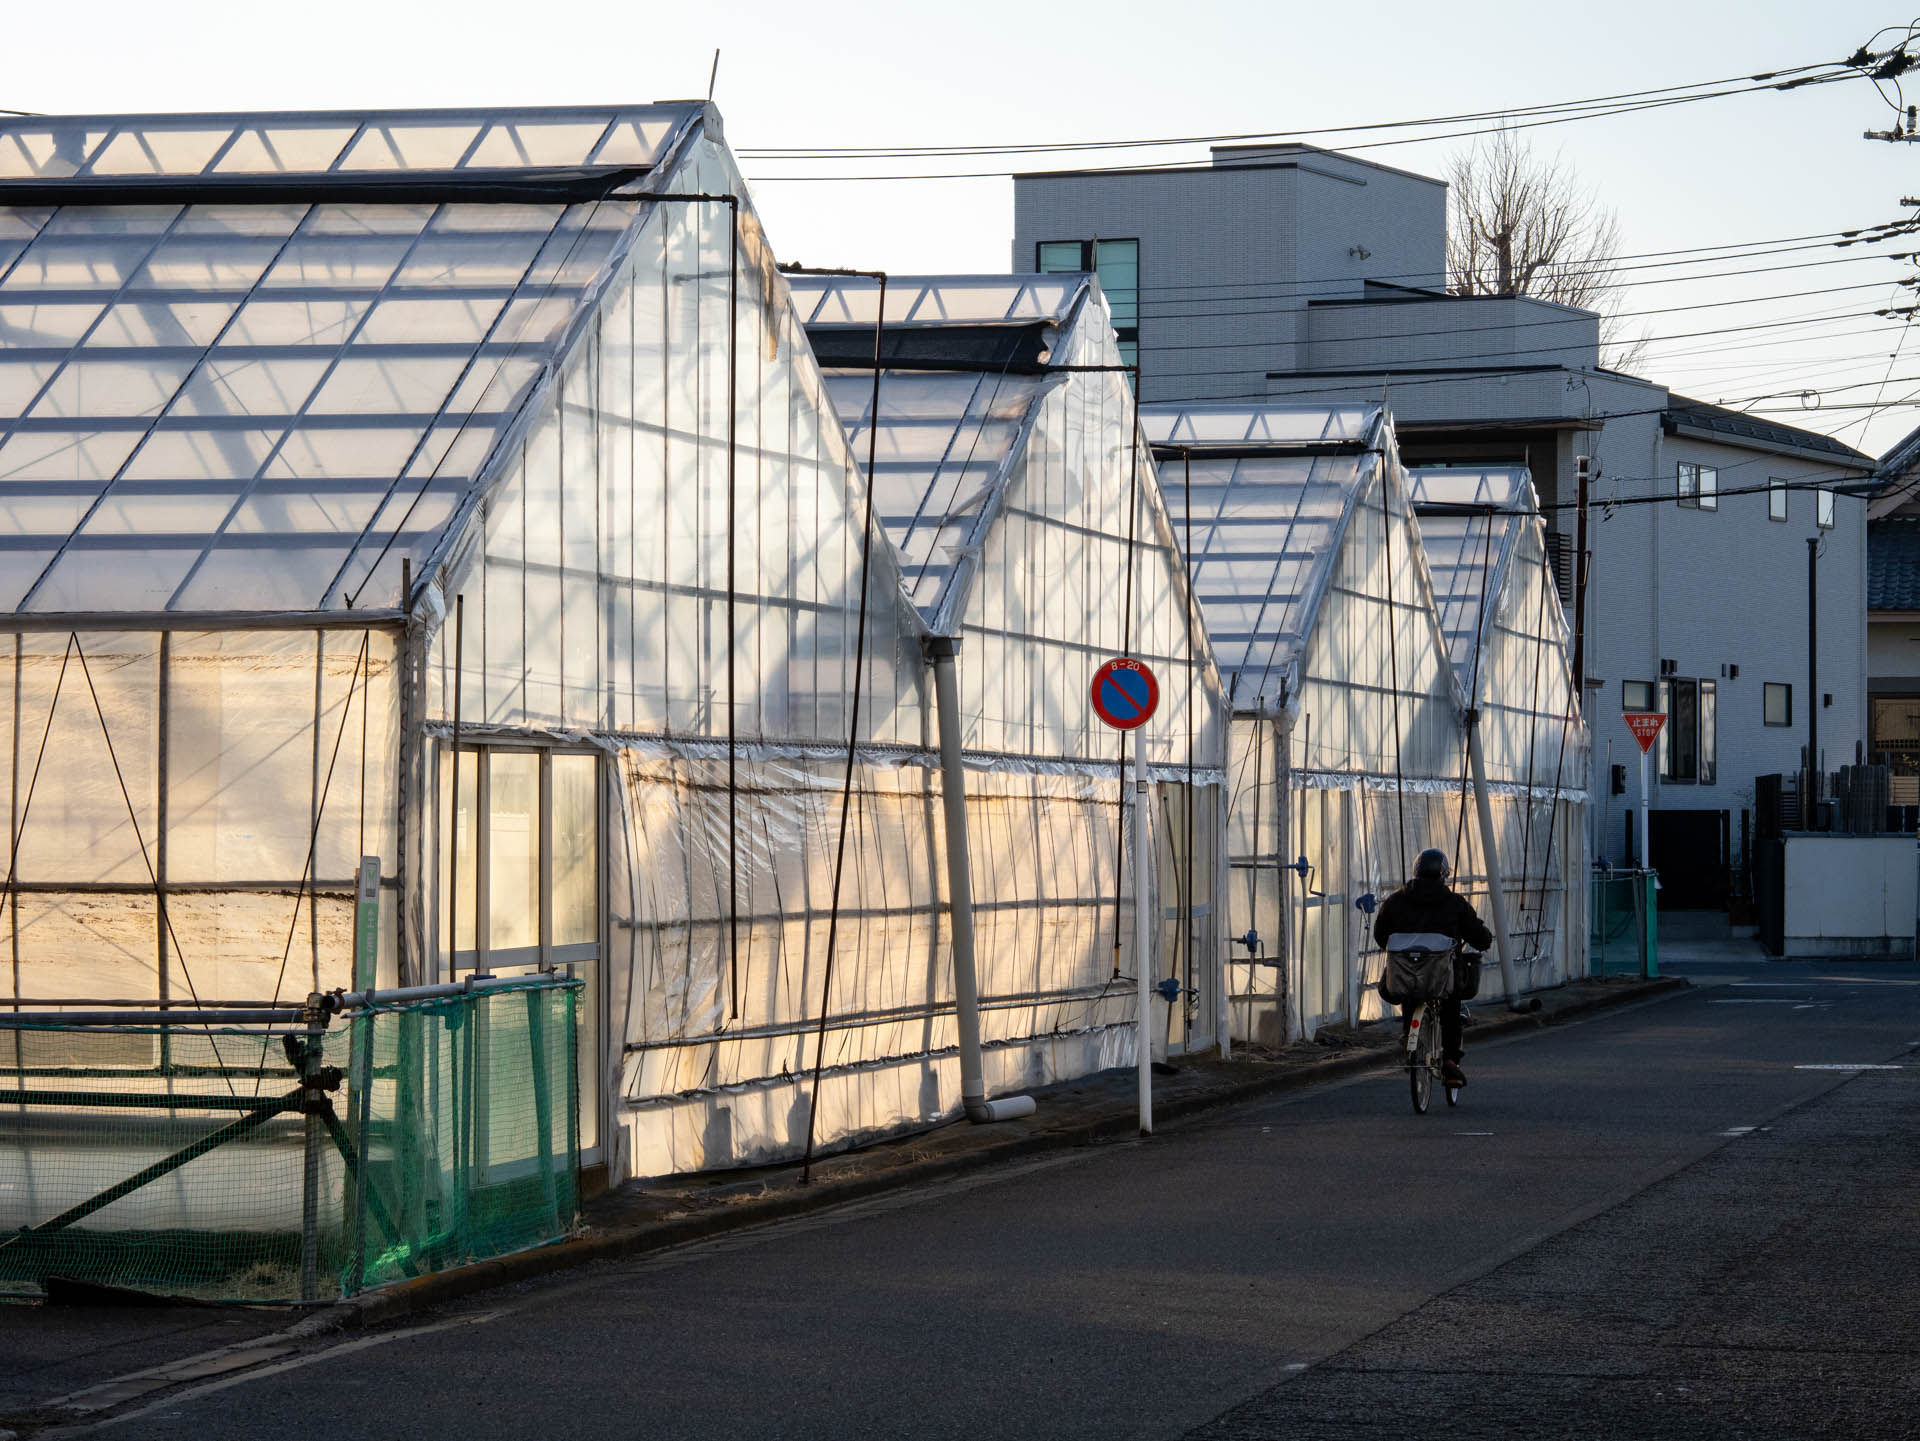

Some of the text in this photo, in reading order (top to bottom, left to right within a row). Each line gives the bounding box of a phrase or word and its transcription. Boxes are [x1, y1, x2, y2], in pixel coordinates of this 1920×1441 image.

[1111, 660, 1140, 672] 8-20
[1631, 717, 1659, 727] 止まれ
[1637, 728, 1656, 737] STOP
